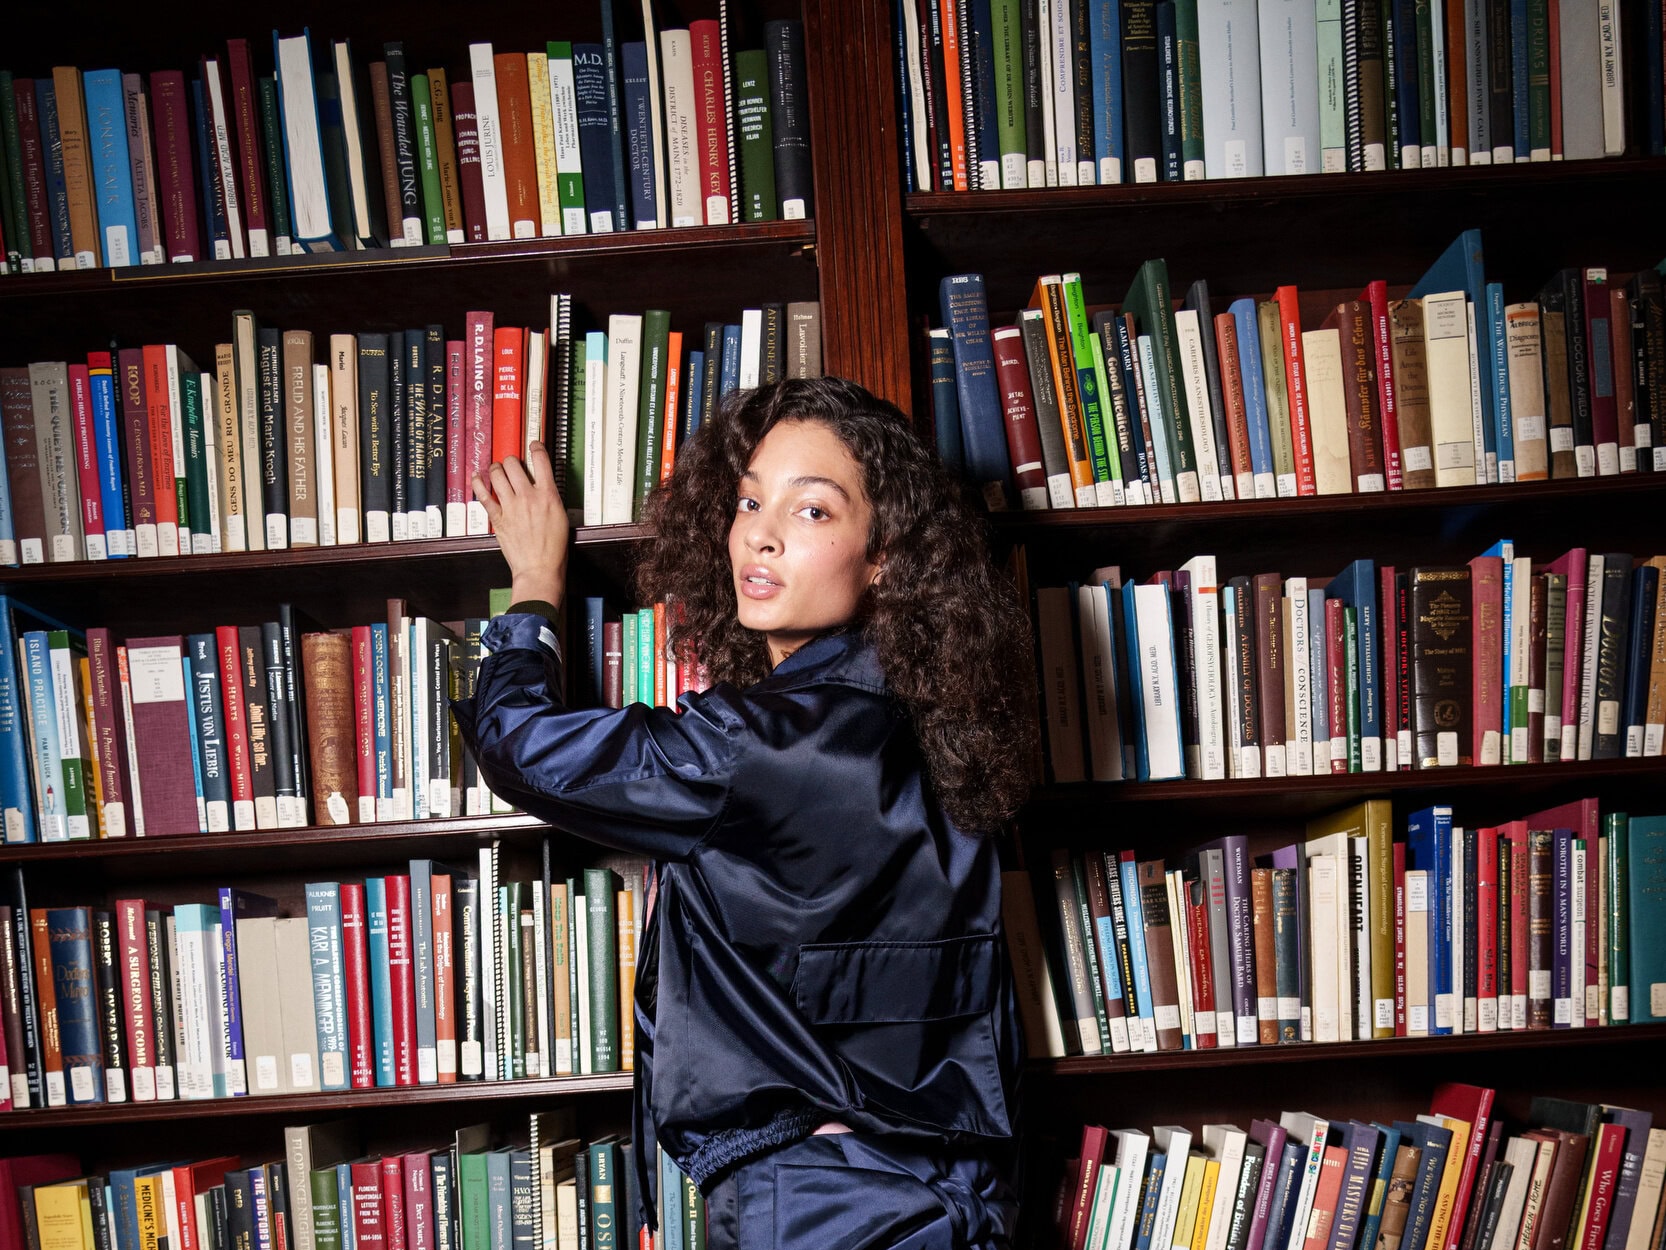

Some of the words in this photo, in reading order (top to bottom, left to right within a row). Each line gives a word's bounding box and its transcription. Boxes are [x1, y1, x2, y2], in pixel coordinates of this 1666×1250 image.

[1028, 30, 1036, 42] His
[574, 54, 603, 65] M.D.
[1029, 45, 1037, 67] Name
[392, 72, 406, 96] The
[433, 80, 444, 99] C.G.
[704, 70, 716, 124] CHARLES
[1030, 85, 1039, 108] Mudd
[127, 89, 139, 137] Memories
[434, 101, 444, 122] Jung
[98, 106, 114, 158] JONAS
[395, 101, 411, 157] Wounded
[24, 139, 36, 160] John
[630, 129, 640, 170] DOCTOR
[637, 96, 651, 201] TWENTIETH-CENTURY
[708, 128, 718, 167] HENRY
[25, 163, 40, 209] Hughlings
[104, 165, 119, 204] SALK
[399, 158, 416, 205] JUNG
[32, 211, 44, 245] Jackson
[1119, 325, 1128, 347] ALMA
[1495, 319, 1504, 336] THE
[260, 345, 271, 386] August
[1108, 357, 1118, 391] Good
[1121, 350, 1132, 371] FARM
[127, 365, 140, 406] KOOP
[291, 366, 304, 403] FREUD
[371, 390, 378, 400] To
[415, 383, 424, 398] THE
[77, 402, 86, 425] HEALTH
[264, 390, 274, 417] and
[415, 400, 425, 427] WING
[265, 419, 274, 447] Marie
[294, 407, 304, 434] AND
[1112, 394, 1131, 452] Medicine
[80, 426, 90, 469] PROFITEERING
[295, 437, 305, 454] HIS
[416, 430, 425, 441] OF
[372, 440, 380, 461] Better
[416, 443, 425, 479] MADNESS
[265, 451, 275, 484] Krogh
[295, 457, 306, 500] FATHER
[372, 463, 380, 476] Eye
[1294, 598, 1305, 653] DOCTORS
[29, 639, 42, 675] ISLAND
[224, 646, 232, 670] KING
[1242, 643, 1251, 677] FAMILY
[1598, 615, 1619, 697] Doctors
[227, 674, 234, 683] OF
[1243, 680, 1251, 692] OF
[33, 679, 47, 726] PRACTICE
[196, 672, 215, 713] JUSTUS
[229, 686, 237, 721] HEARTS
[1298, 668, 1308, 743] CONSCIENCE
[203, 716, 213, 736] VON
[249, 703, 263, 722] John
[1244, 694, 1254, 740] DOCTORS
[250, 723, 265, 742] Lilly,
[205, 739, 220, 778] LIEBIG
[254, 742, 265, 752] so
[255, 753, 268, 772] far...
[1380, 823, 1388, 850] Pioneers
[1107, 855, 1117, 879] DISEASE
[1380, 857, 1388, 883] Surgical
[1577, 854, 1585, 883] combat
[1109, 879, 1121, 905] FIGHTERS
[1560, 880, 1567, 888] IN
[1114, 906, 1124, 923] SINCE
[1232, 896, 1242, 930] DOCTOR
[1576, 887, 1584, 917] surgeon
[127, 907, 135, 940] McDermott
[129, 946, 138, 955] A
[311, 926, 327, 952] KARL
[1234, 932, 1242, 962] SAMUEL
[314, 958, 326, 969] A.
[129, 956, 141, 1010] SURGEON
[420, 975, 428, 1009] Anatomist
[1245, 975, 1252, 985] OF
[314, 973, 333, 1034] MENNINGER
[133, 1015, 142, 1026] IN
[292, 1139, 306, 1204] FLORENCE
[598, 1153, 606, 1180] BRYAN
[1237, 1155, 1255, 1198] Founders
[1428, 1157, 1438, 1173] WE
[254, 1177, 265, 1195] THE
[1421, 1173, 1434, 1194] WILL
[1598, 1170, 1612, 1194] Who
[141, 1185, 154, 1230] MEDICINE'S
[1236, 1200, 1245, 1210] of
[1339, 1174, 1365, 1221] MASTERS
[1418, 1197, 1429, 1213] NOT
[1437, 1194, 1450, 1218] SAVING
[1595, 1197, 1607, 1221] Goes
[256, 1199, 270, 1239] DOCTORS
[415, 1203, 424, 1220] Ever
[1416, 1215, 1425, 1227] BE
[416, 1223, 426, 1245] Yours,
[1229, 1212, 1244, 1244] British
[1336, 1224, 1348, 1238] OF
[1433, 1219, 1445, 1240] THE
